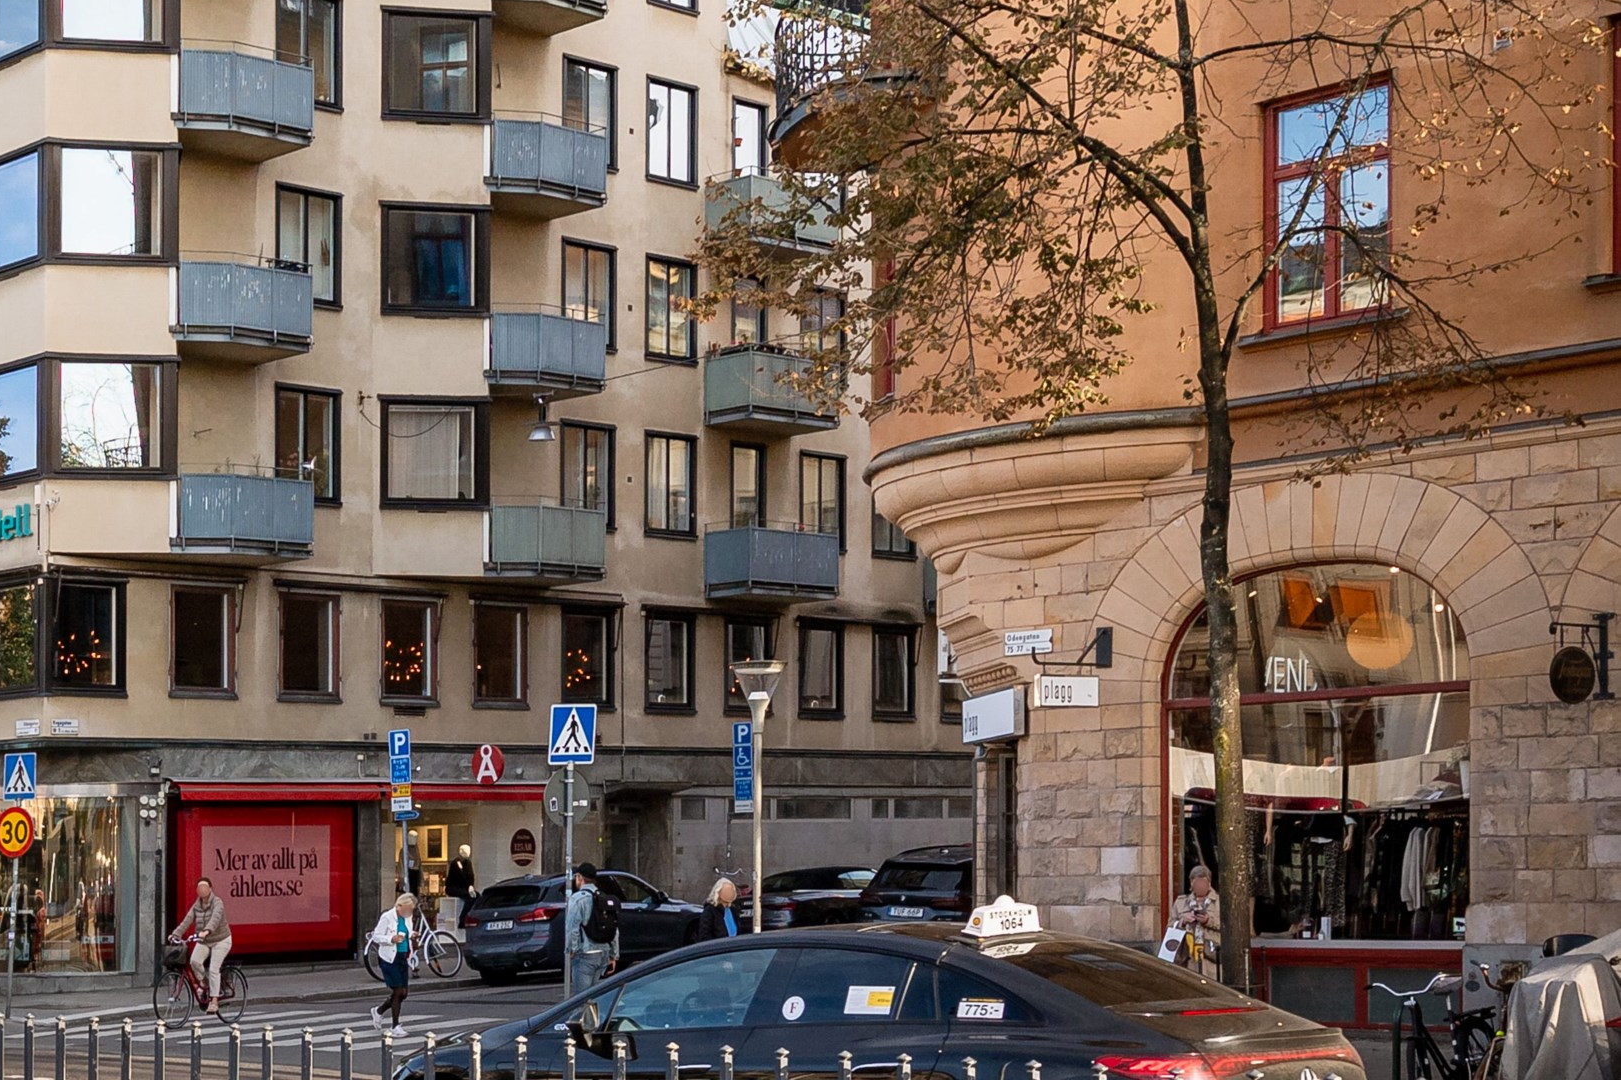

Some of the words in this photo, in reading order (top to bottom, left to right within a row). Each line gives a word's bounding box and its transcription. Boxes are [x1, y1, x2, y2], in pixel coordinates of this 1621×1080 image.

[1006, 633, 1040, 643] Odengatan
[1006, 645, 1014, 654] 75
[1044, 680, 1073, 703] plagg
[737, 725, 749, 743] P
[393, 732, 406, 755] P
[477, 744, 499, 784] Å
[2, 820, 28, 844] 30
[214, 848, 249, 871] Mer
[251, 853, 270, 870] av
[272, 847, 296, 870] allt
[299, 846, 318, 876] på
[230, 874, 304, 898] åhlens.se
[990, 909, 1032, 920] STOCKHOLM
[1000, 918, 1023, 931] 1064
[789, 1002, 799, 1014] F
[964, 1004, 999, 1016] 775:-
